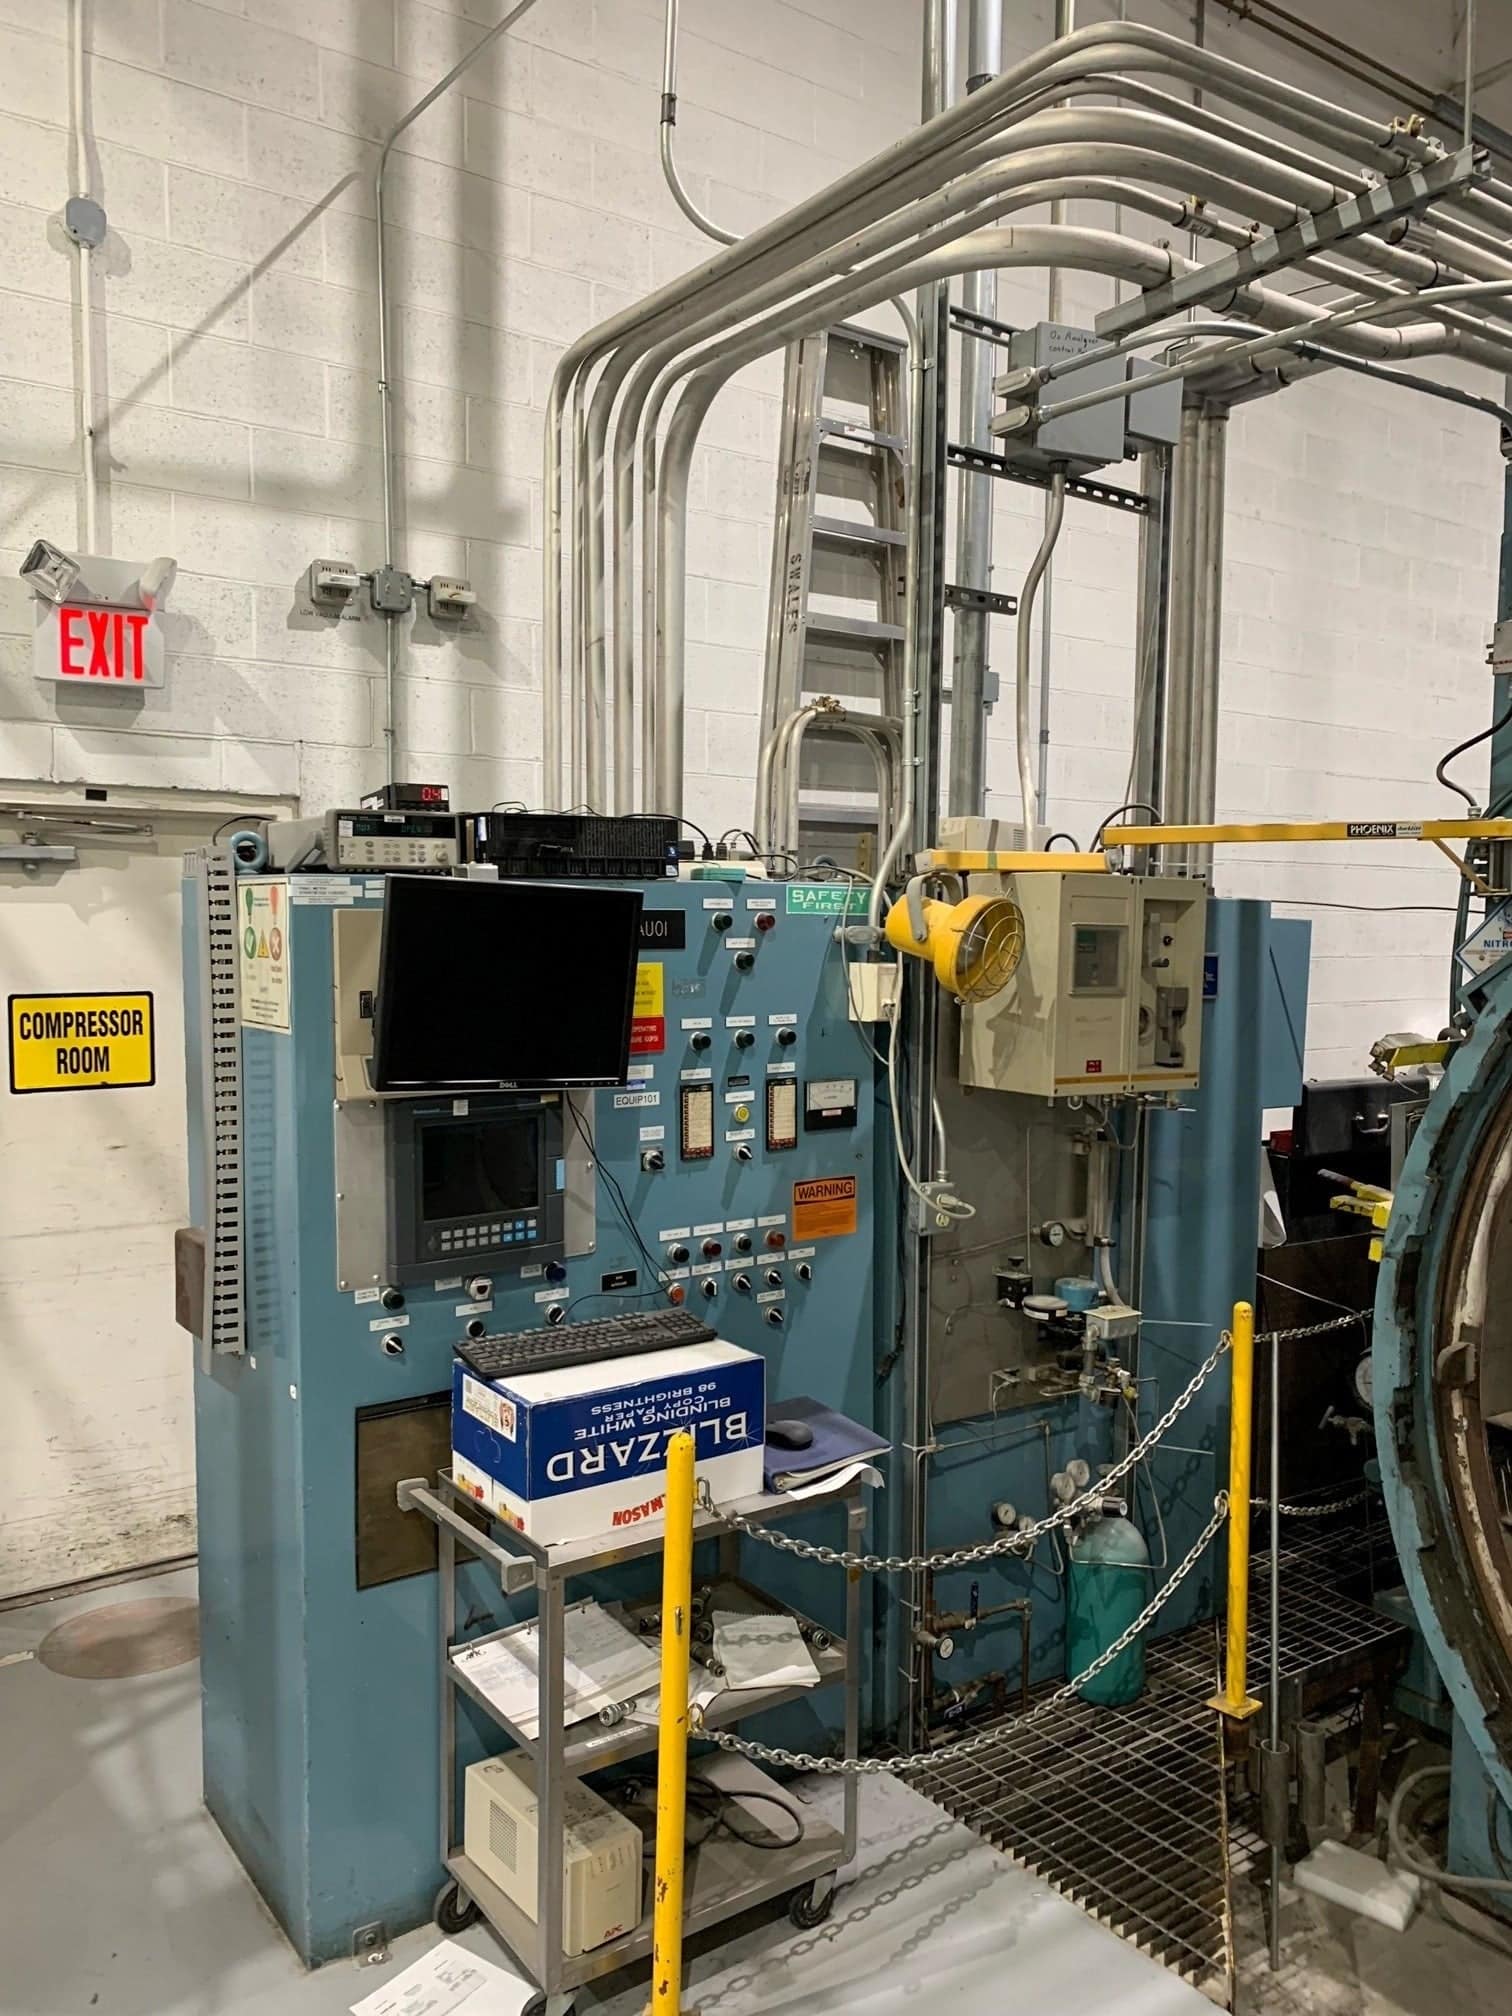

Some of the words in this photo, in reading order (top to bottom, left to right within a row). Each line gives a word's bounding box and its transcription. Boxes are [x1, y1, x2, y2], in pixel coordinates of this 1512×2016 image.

[60, 608, 148, 680] EXIT
[1350, 824, 1394, 834] PHOENIX
[792, 889, 866, 904] SAFETY
[802, 902, 856, 910] FIRST
[19, 1009, 143, 1040] COMPRESSOR
[56, 1046, 110, 1075] ROOM
[616, 1095, 658, 1106] EQUIP101
[798, 1182, 853, 1200] WARNING
[698, 1381, 717, 1391] 98
[591, 1387, 693, 1415] BRIGHTNESS
[643, 1396, 731, 1424] BLINDING
[663, 1395, 704, 1410] COPY
[605, 1405, 655, 1423] PAPER
[574, 1419, 636, 1441] WHITE
[604, 1924, 623, 1939] APC
